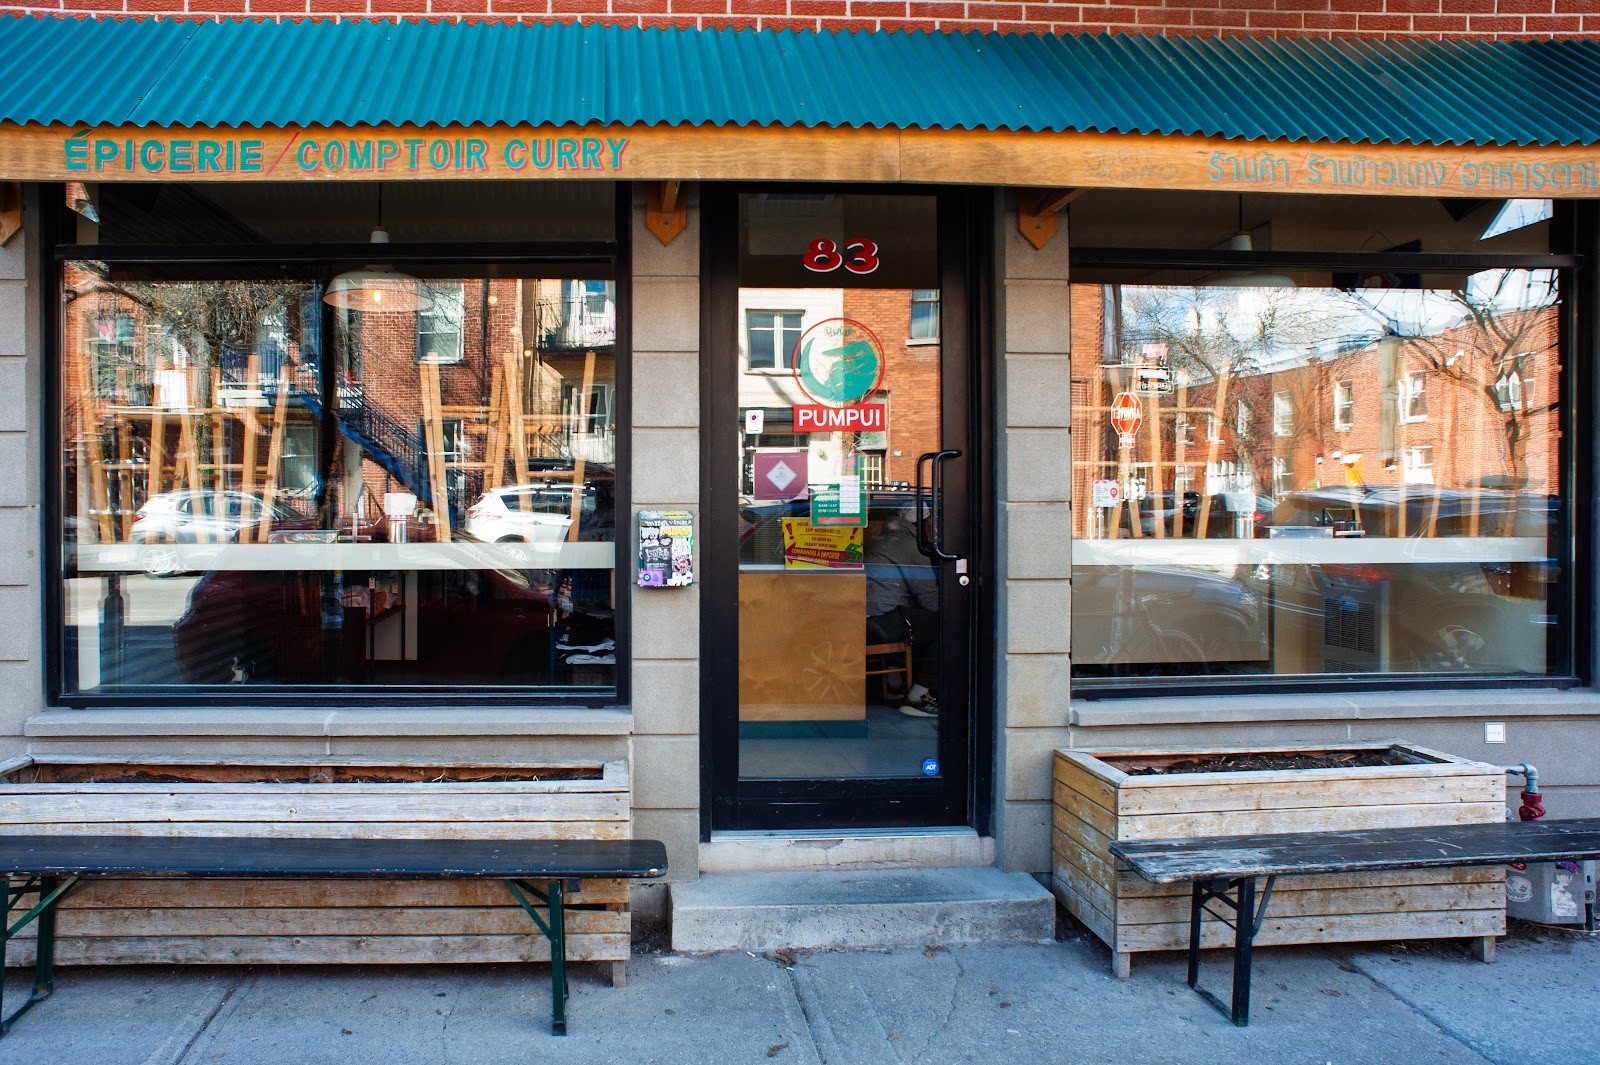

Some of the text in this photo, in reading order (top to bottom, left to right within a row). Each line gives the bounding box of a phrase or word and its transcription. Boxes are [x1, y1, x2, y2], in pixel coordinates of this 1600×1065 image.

[64, 129, 265, 174] ÉPICERIE
[297, 138, 490, 173] COMPTOIR
[503, 137, 631, 173] CURRY
[803, 237, 880, 275] 83
[798, 408, 881, 427] PUMPUI
[925, 763, 937, 771] ADT
